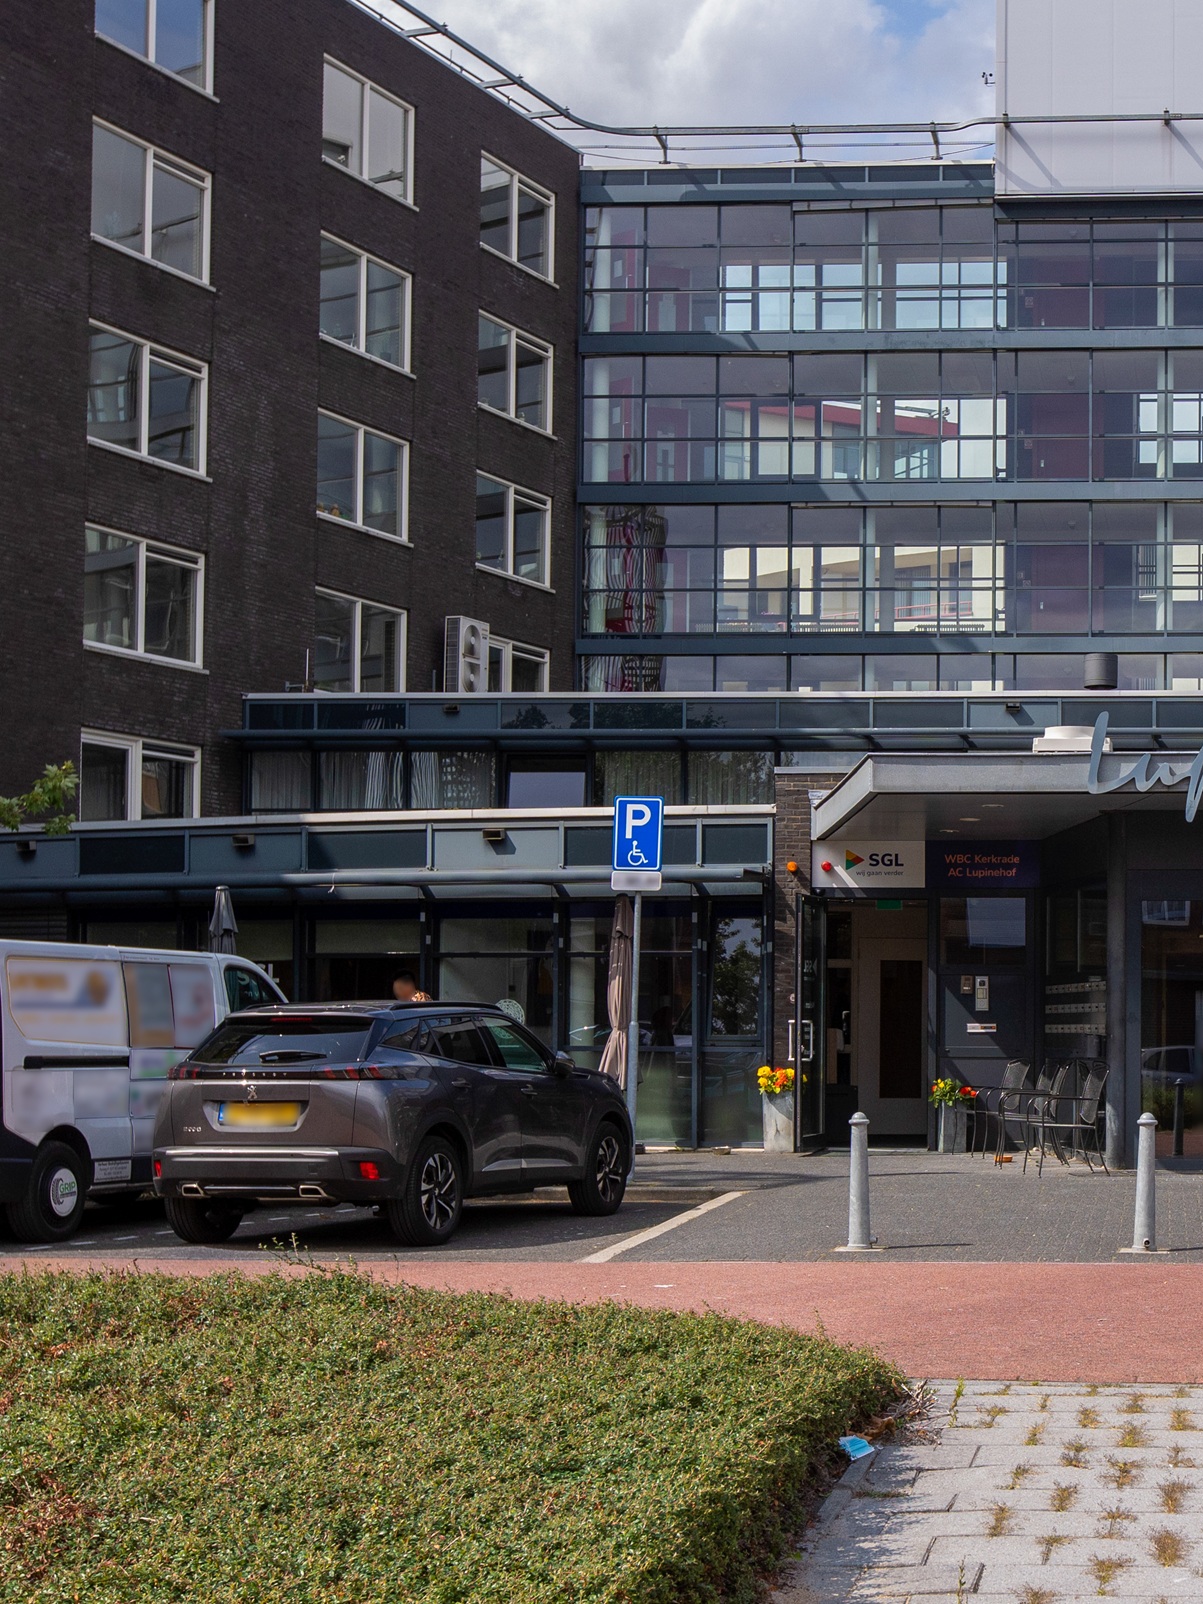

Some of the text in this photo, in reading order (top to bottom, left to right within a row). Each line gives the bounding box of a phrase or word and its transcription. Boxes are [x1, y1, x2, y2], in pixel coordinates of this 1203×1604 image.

[625, 803, 652, 839] P
[868, 853, 904, 867] SGL
[944, 854, 1020, 864] WBC Kerkrade
[948, 867, 1017, 878] AC Lupinehof
[60, 1181, 76, 1194] GRIP
